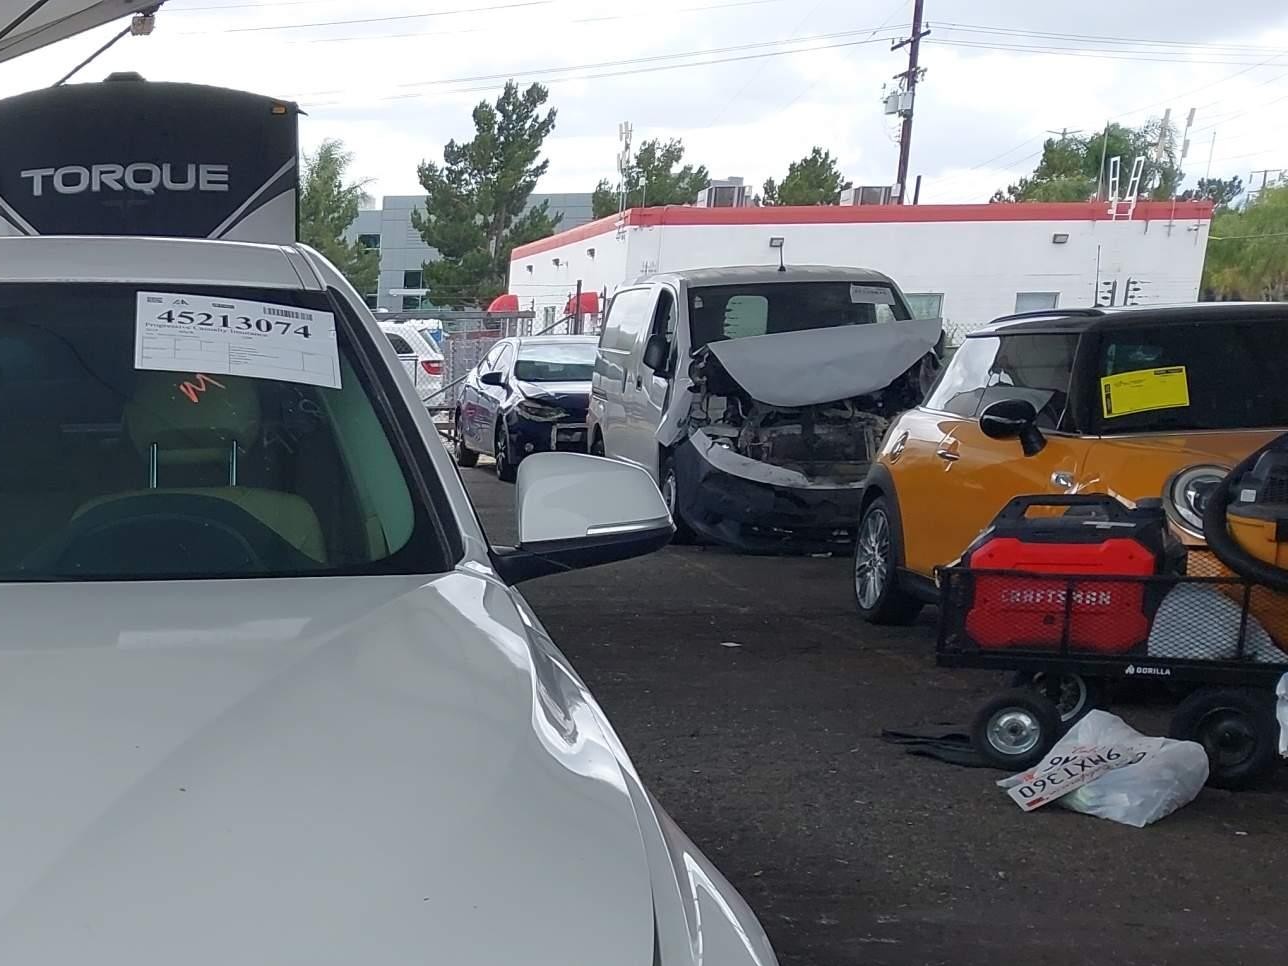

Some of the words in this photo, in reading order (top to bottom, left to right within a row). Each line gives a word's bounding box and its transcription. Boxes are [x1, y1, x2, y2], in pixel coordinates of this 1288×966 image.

[20, 162, 229, 197] TORQUE
[157, 309, 312, 339] 45213074
[1136, 666, 1171, 676] GORILLA
